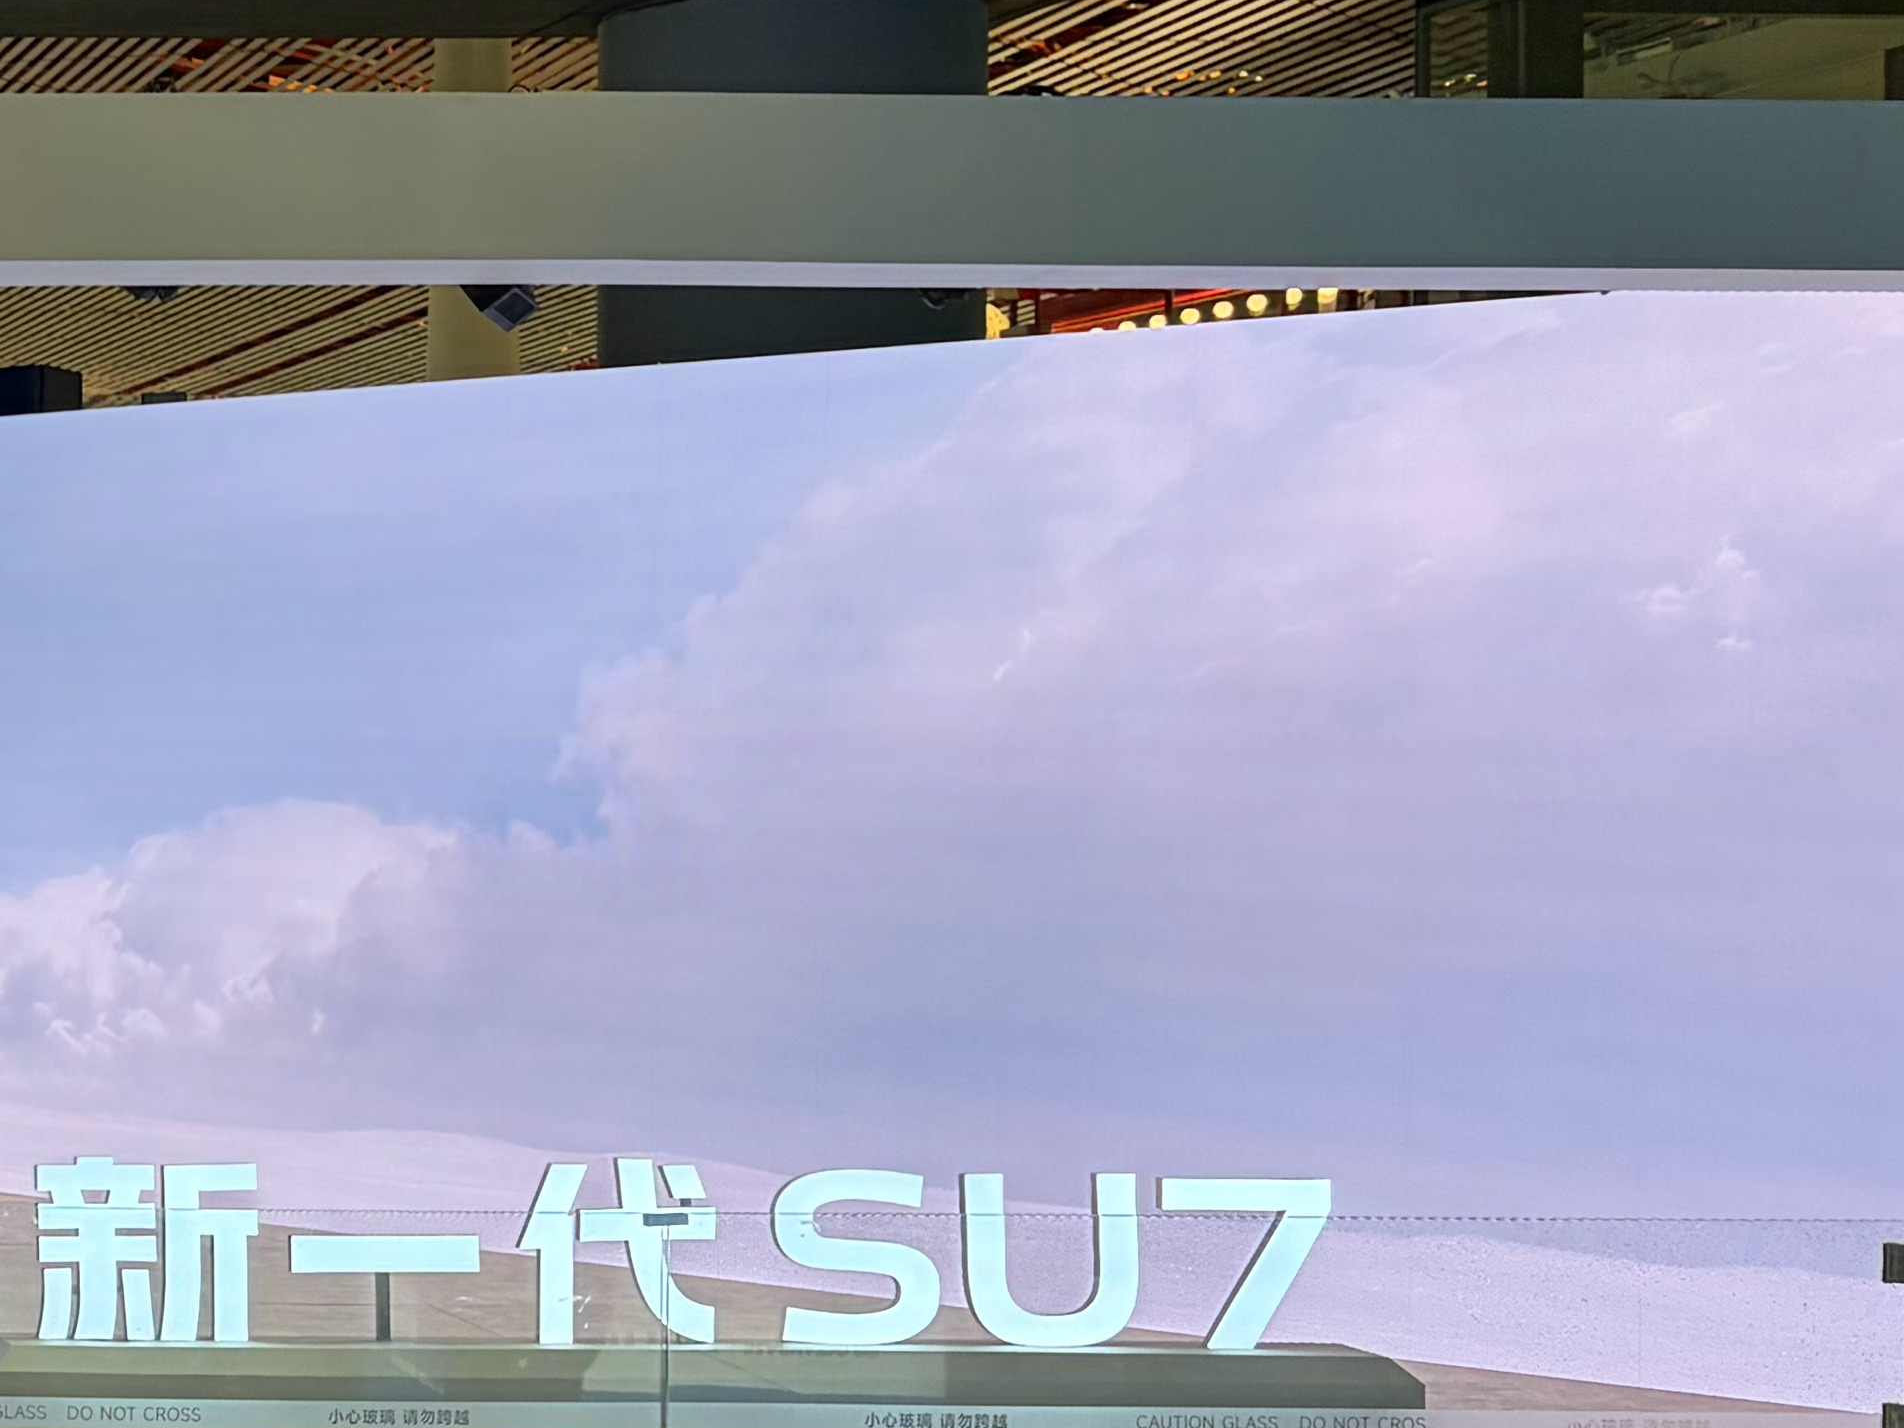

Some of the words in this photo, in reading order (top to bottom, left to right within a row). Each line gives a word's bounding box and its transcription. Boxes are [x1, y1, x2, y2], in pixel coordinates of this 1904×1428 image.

[66, 1405, 93, 1422] DO
[100, 1406, 135, 1422] NOT
[143, 1406, 202, 1423] CROSS
